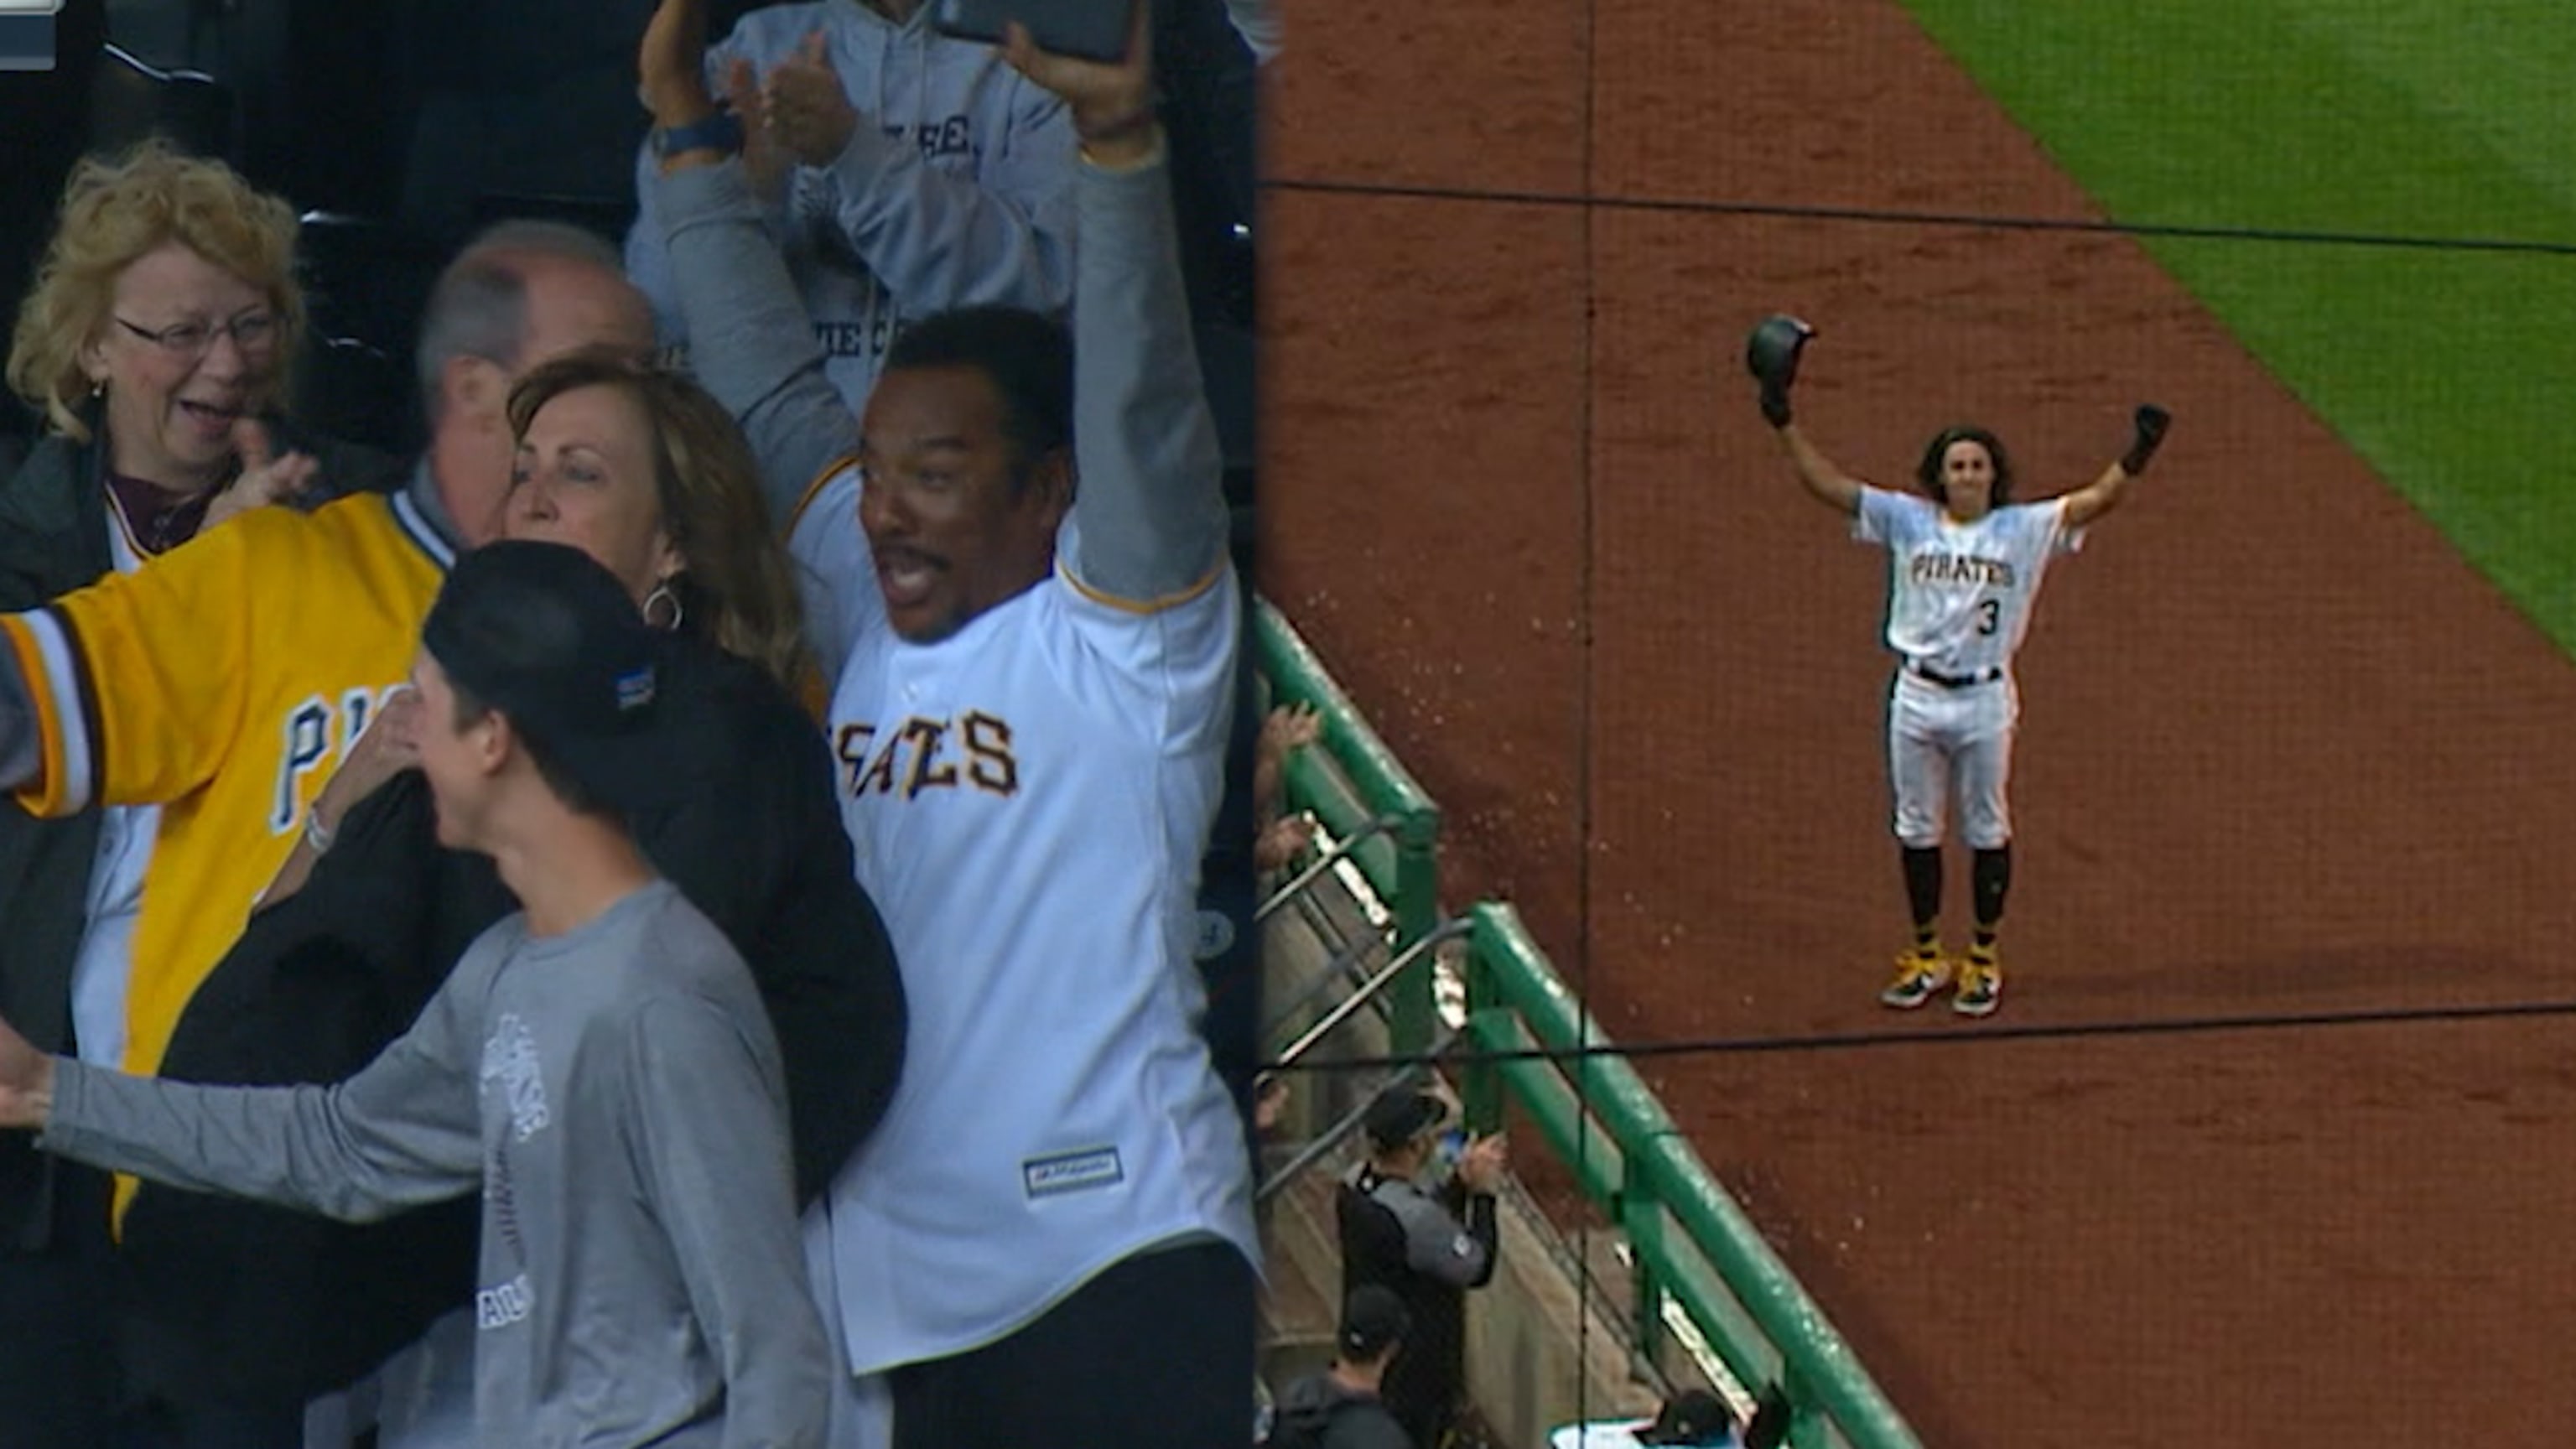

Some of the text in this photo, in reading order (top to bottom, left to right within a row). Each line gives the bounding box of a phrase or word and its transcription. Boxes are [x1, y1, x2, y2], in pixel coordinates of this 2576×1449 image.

[1911, 553, 2015, 588] PIRATES
[1976, 598, 2001, 636] 3
[826, 709, 1020, 802] RATES
